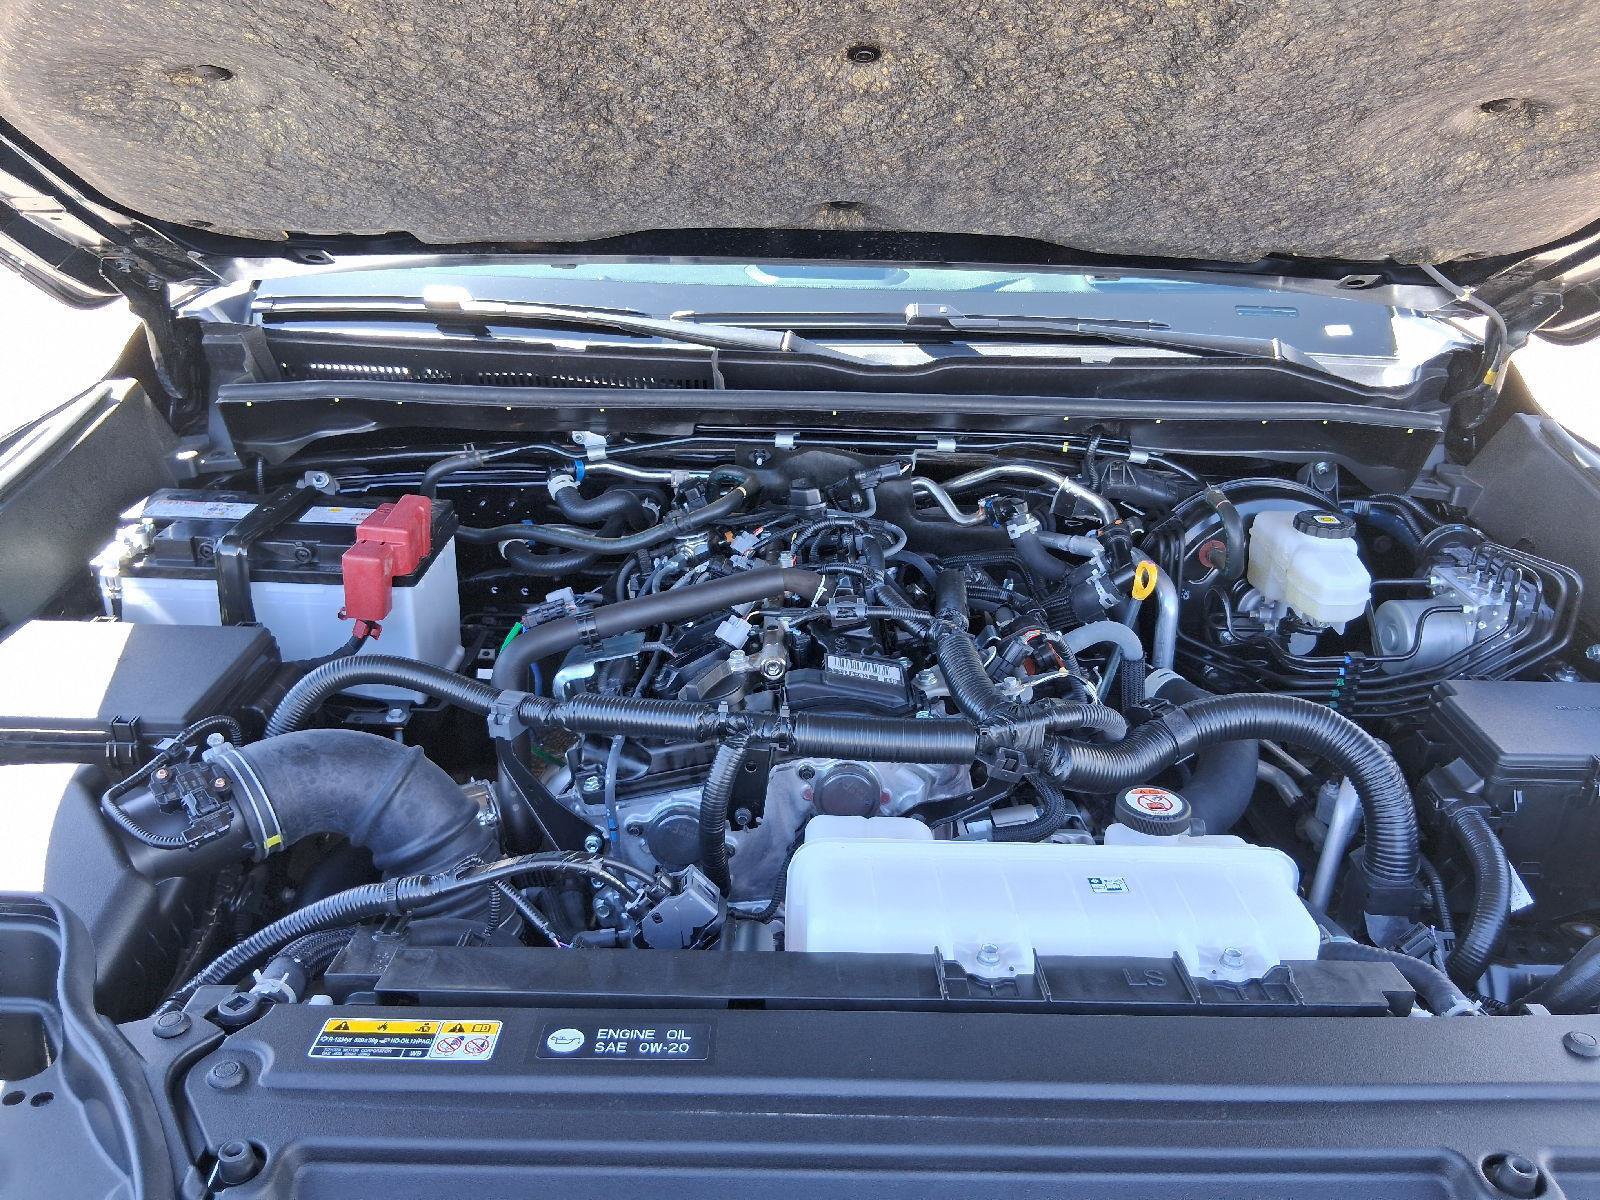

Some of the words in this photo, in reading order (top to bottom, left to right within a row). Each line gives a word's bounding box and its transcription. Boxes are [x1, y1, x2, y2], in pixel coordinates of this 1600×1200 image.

[1122, 968, 1167, 986] LS
[597, 1028, 656, 1040] ENGINE
[666, 1029, 692, 1040] OIL
[594, 1042, 628, 1053] SAE
[639, 1042, 690, 1053] 0W-20
